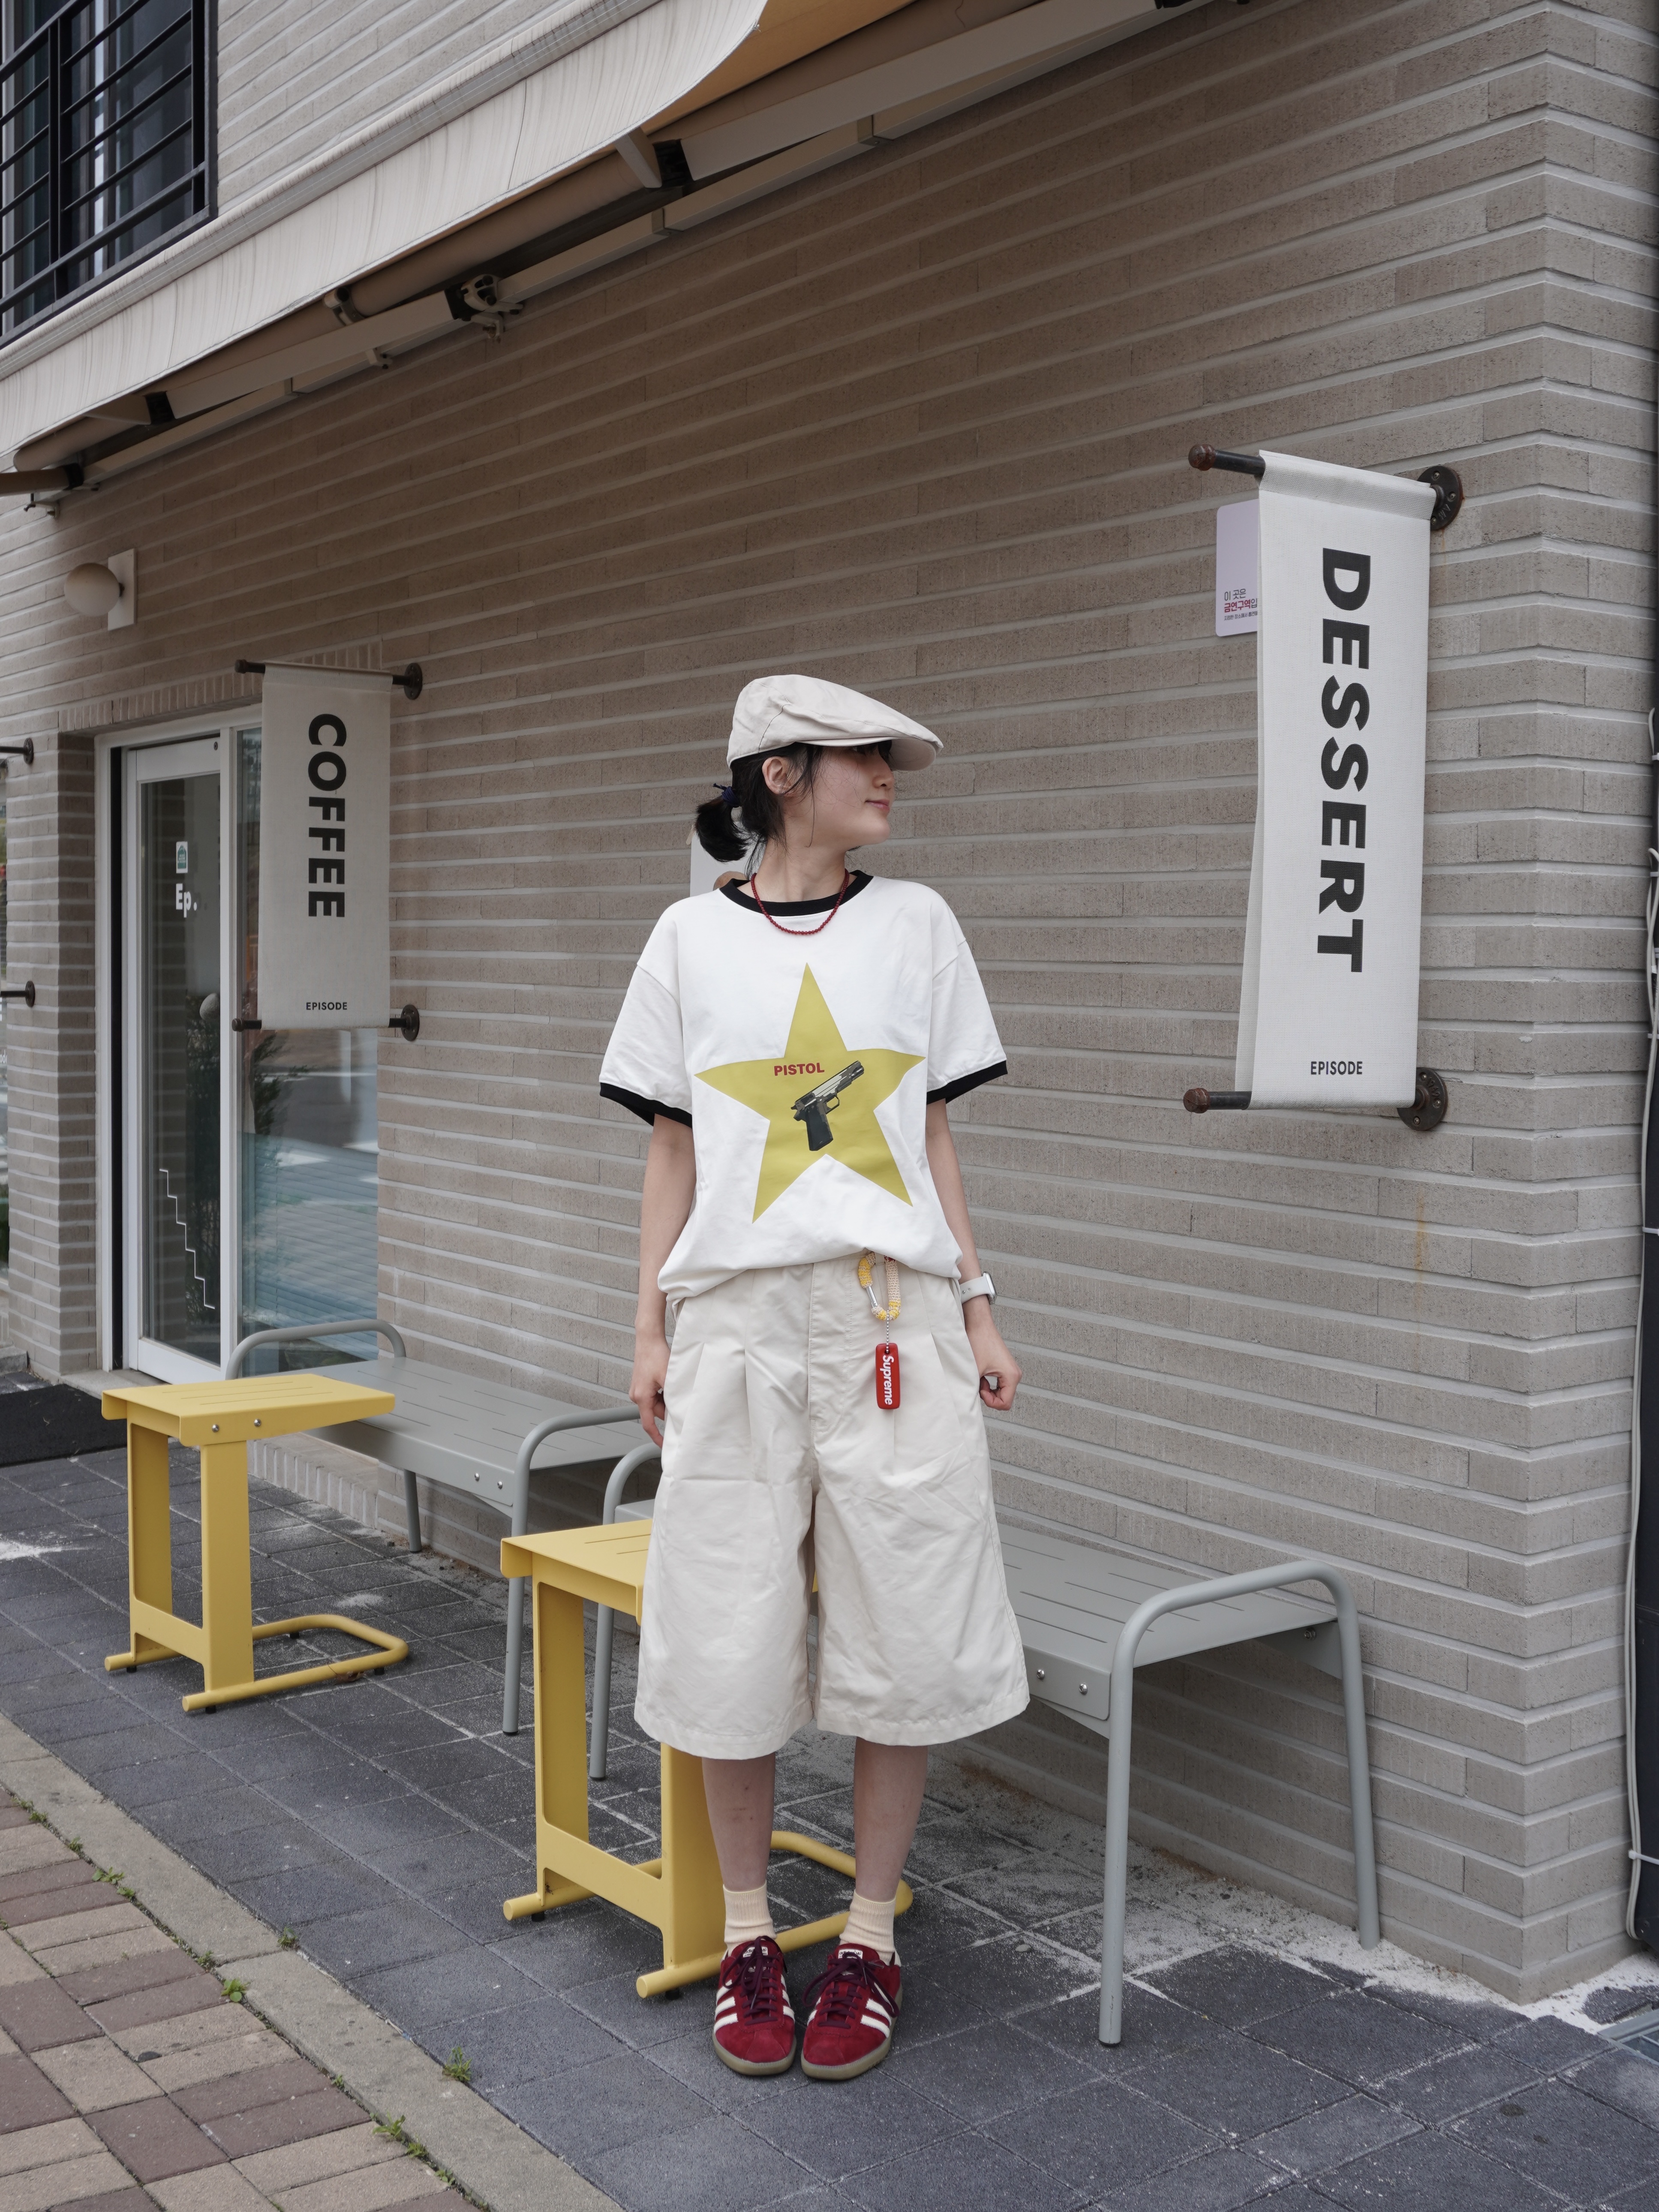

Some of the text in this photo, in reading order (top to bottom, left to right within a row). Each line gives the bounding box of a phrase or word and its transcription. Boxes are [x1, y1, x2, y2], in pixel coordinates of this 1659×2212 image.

[1224, 589, 1246, 601] 이 곳은
[1318, 547, 1371, 973] DESSERT
[308, 713, 347, 918] COFFEE
[176, 884, 197, 918] Ep.
[306, 1002, 348, 1010] EPISODE
[774, 1062, 825, 1076] PISTOL
[1310, 1061, 1363, 1075] EPISODE
[880, 1355, 894, 1405] Supreme
